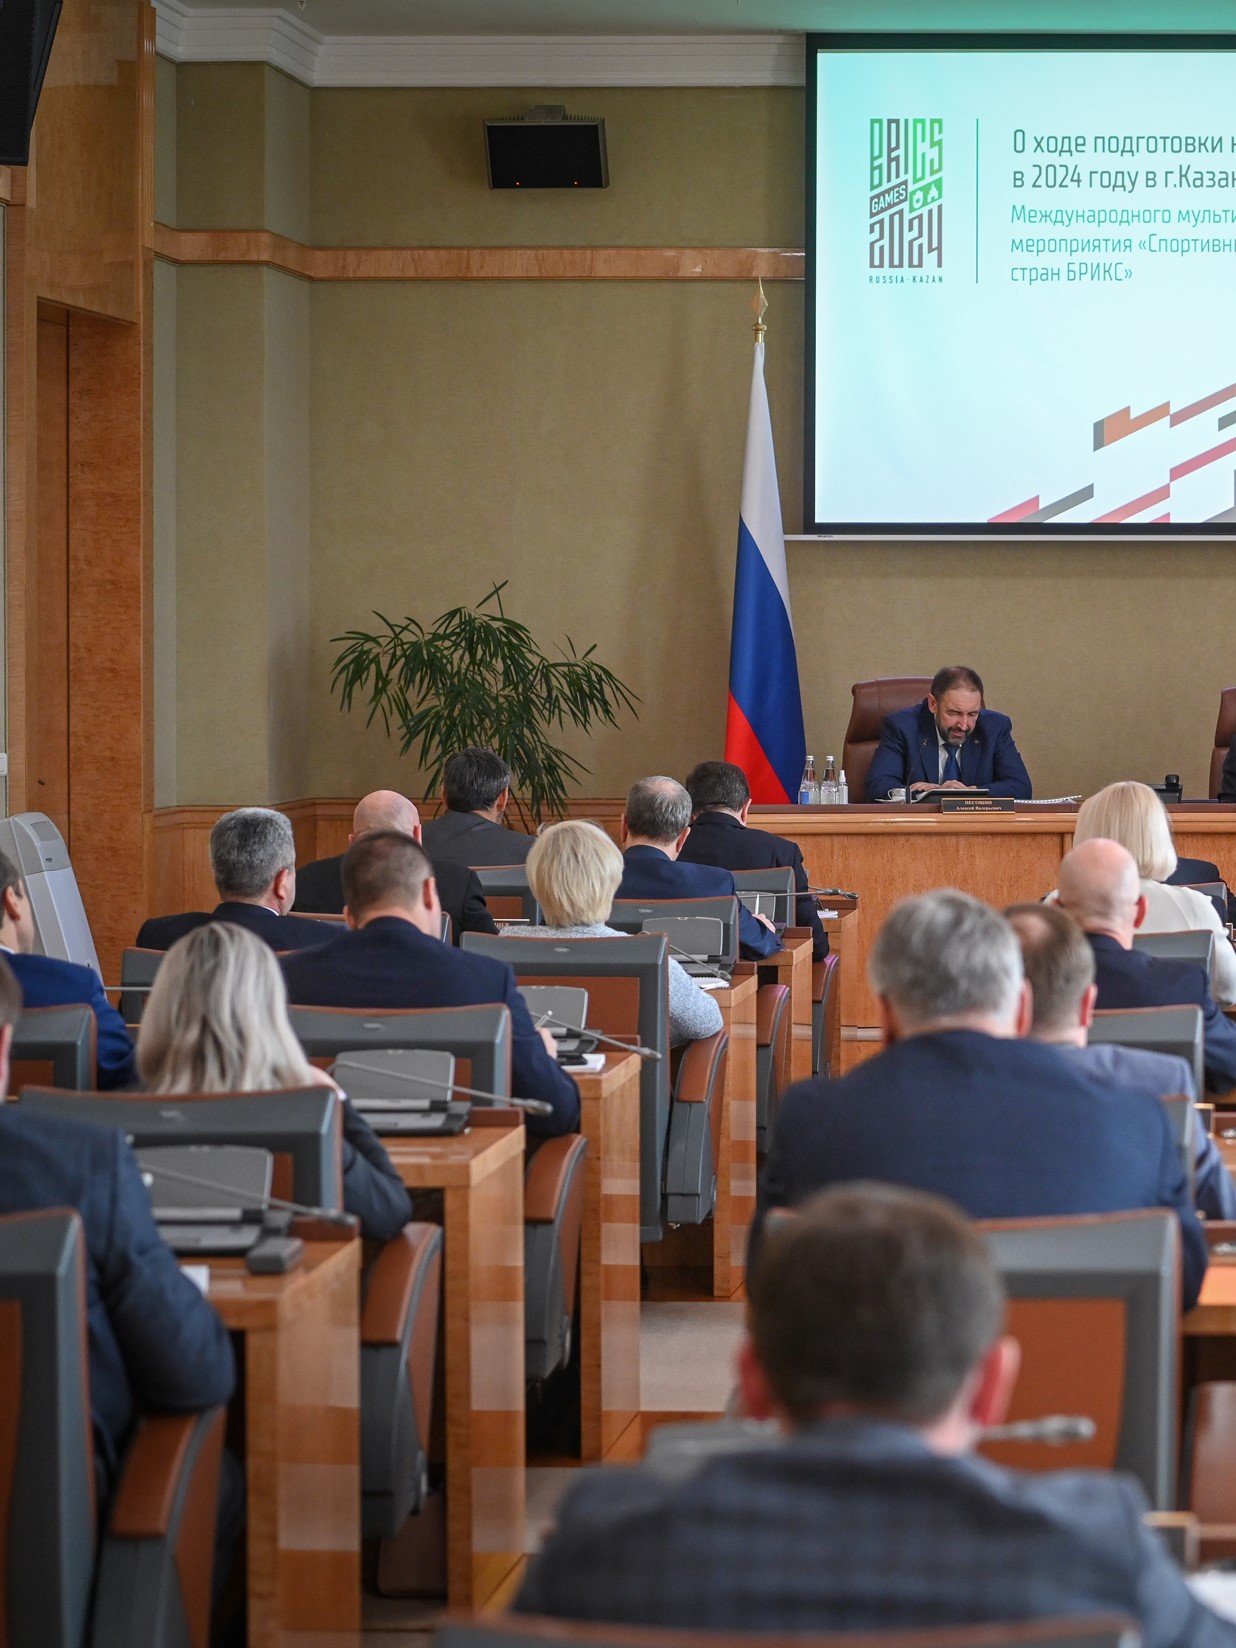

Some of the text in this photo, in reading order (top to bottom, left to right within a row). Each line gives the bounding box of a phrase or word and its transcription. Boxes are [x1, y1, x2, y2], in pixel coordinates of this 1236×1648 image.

[870, 118, 943, 191] BRICS
[1014, 128, 1026, 154] О
[1033, 135, 1087, 158] ходе
[1094, 135, 1223, 158] подготовки
[1013, 170, 1025, 189] в
[1032, 164, 1082, 189] 2024
[1089, 170, 1139, 193] году
[1146, 170, 1157, 189] в
[871, 184, 906, 213] GAMES
[1011, 204, 1171, 227] Международного
[869, 203, 943, 268] 2024
[1011, 237, 1132, 257] мероприятия
[1011, 262, 1132, 286] стран БРИКС»
